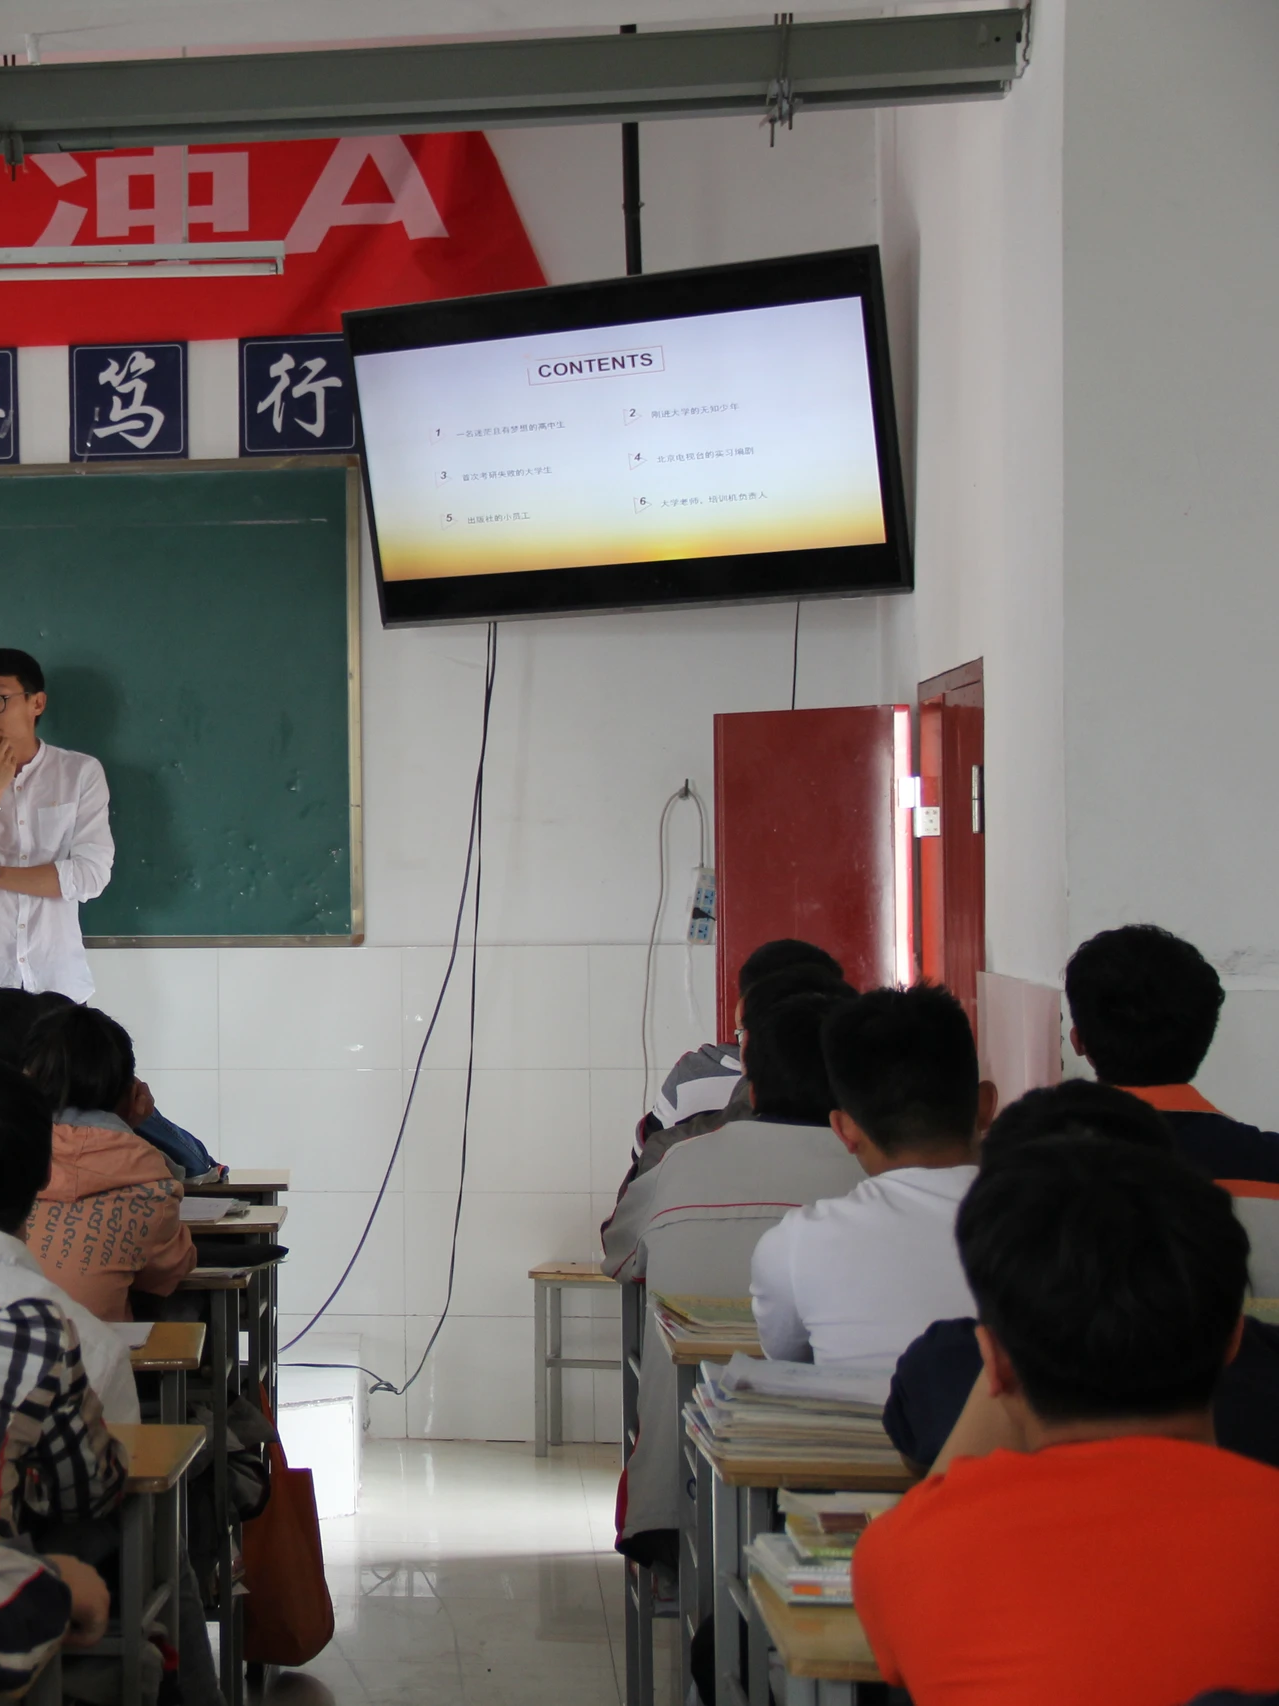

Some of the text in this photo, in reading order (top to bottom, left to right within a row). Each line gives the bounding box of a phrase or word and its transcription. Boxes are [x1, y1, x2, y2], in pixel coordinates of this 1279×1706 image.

[538, 352, 654, 379] CONTENTS
[629, 402, 740, 419] 2 刚进大学的无知少年
[434, 420, 566, 438] 1 一名迷茫且有梦想的高中生
[634, 446, 755, 464] 4 北京电视台的实习编剧
[440, 466, 553, 482] 3 首次考研失败的大学生
[639, 496, 646, 506] 6
[445, 511, 531, 525] 5 出版社的小员工
